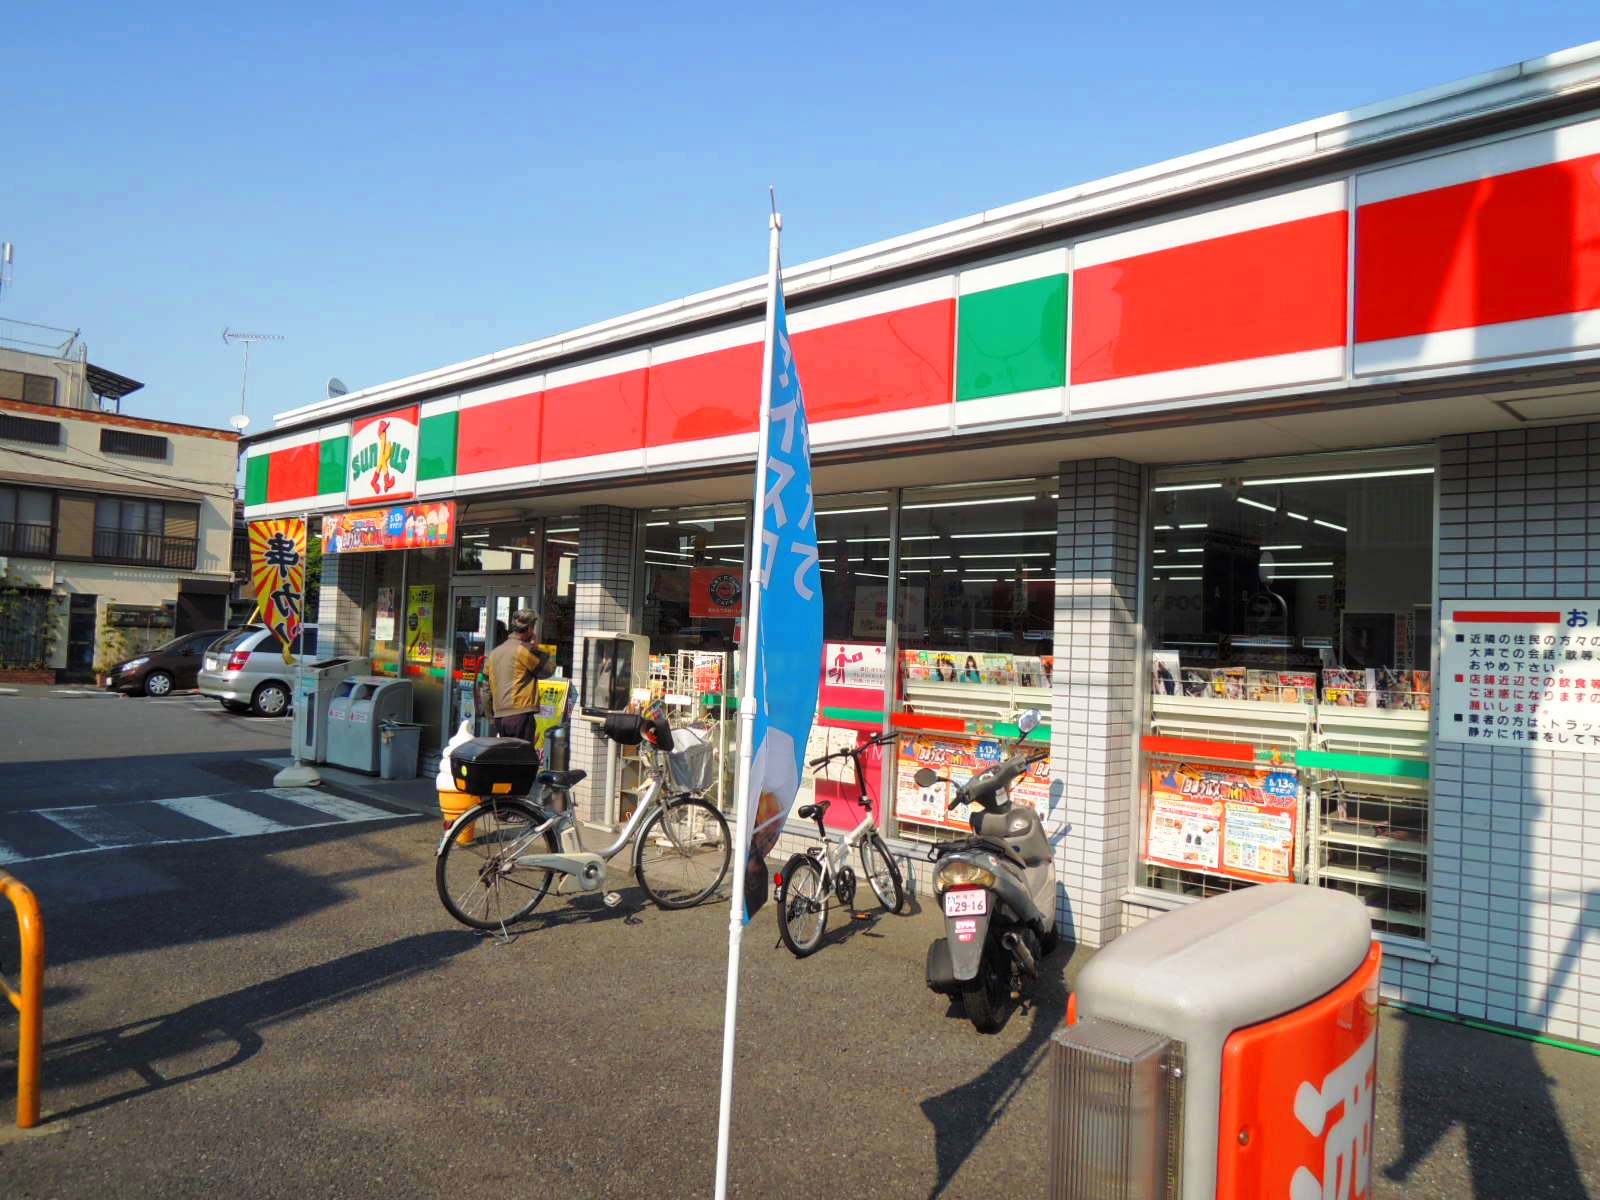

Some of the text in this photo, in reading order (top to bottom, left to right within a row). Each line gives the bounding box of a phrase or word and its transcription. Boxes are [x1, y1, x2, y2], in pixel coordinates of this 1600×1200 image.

[1567, 609, 1600, 627] お
[1469, 633, 1600, 647] 近隣の住民の方々の
[1469, 660, 1564, 675] おやめ下さい。
[1469, 688, 1600, 703] ご迷惑になりますの
[1469, 700, 1549, 714] 願いします。
[1468, 714, 1600, 731] 業者の方は、トラッ
[1468, 726, 1600, 745] 静かに作業をして下
